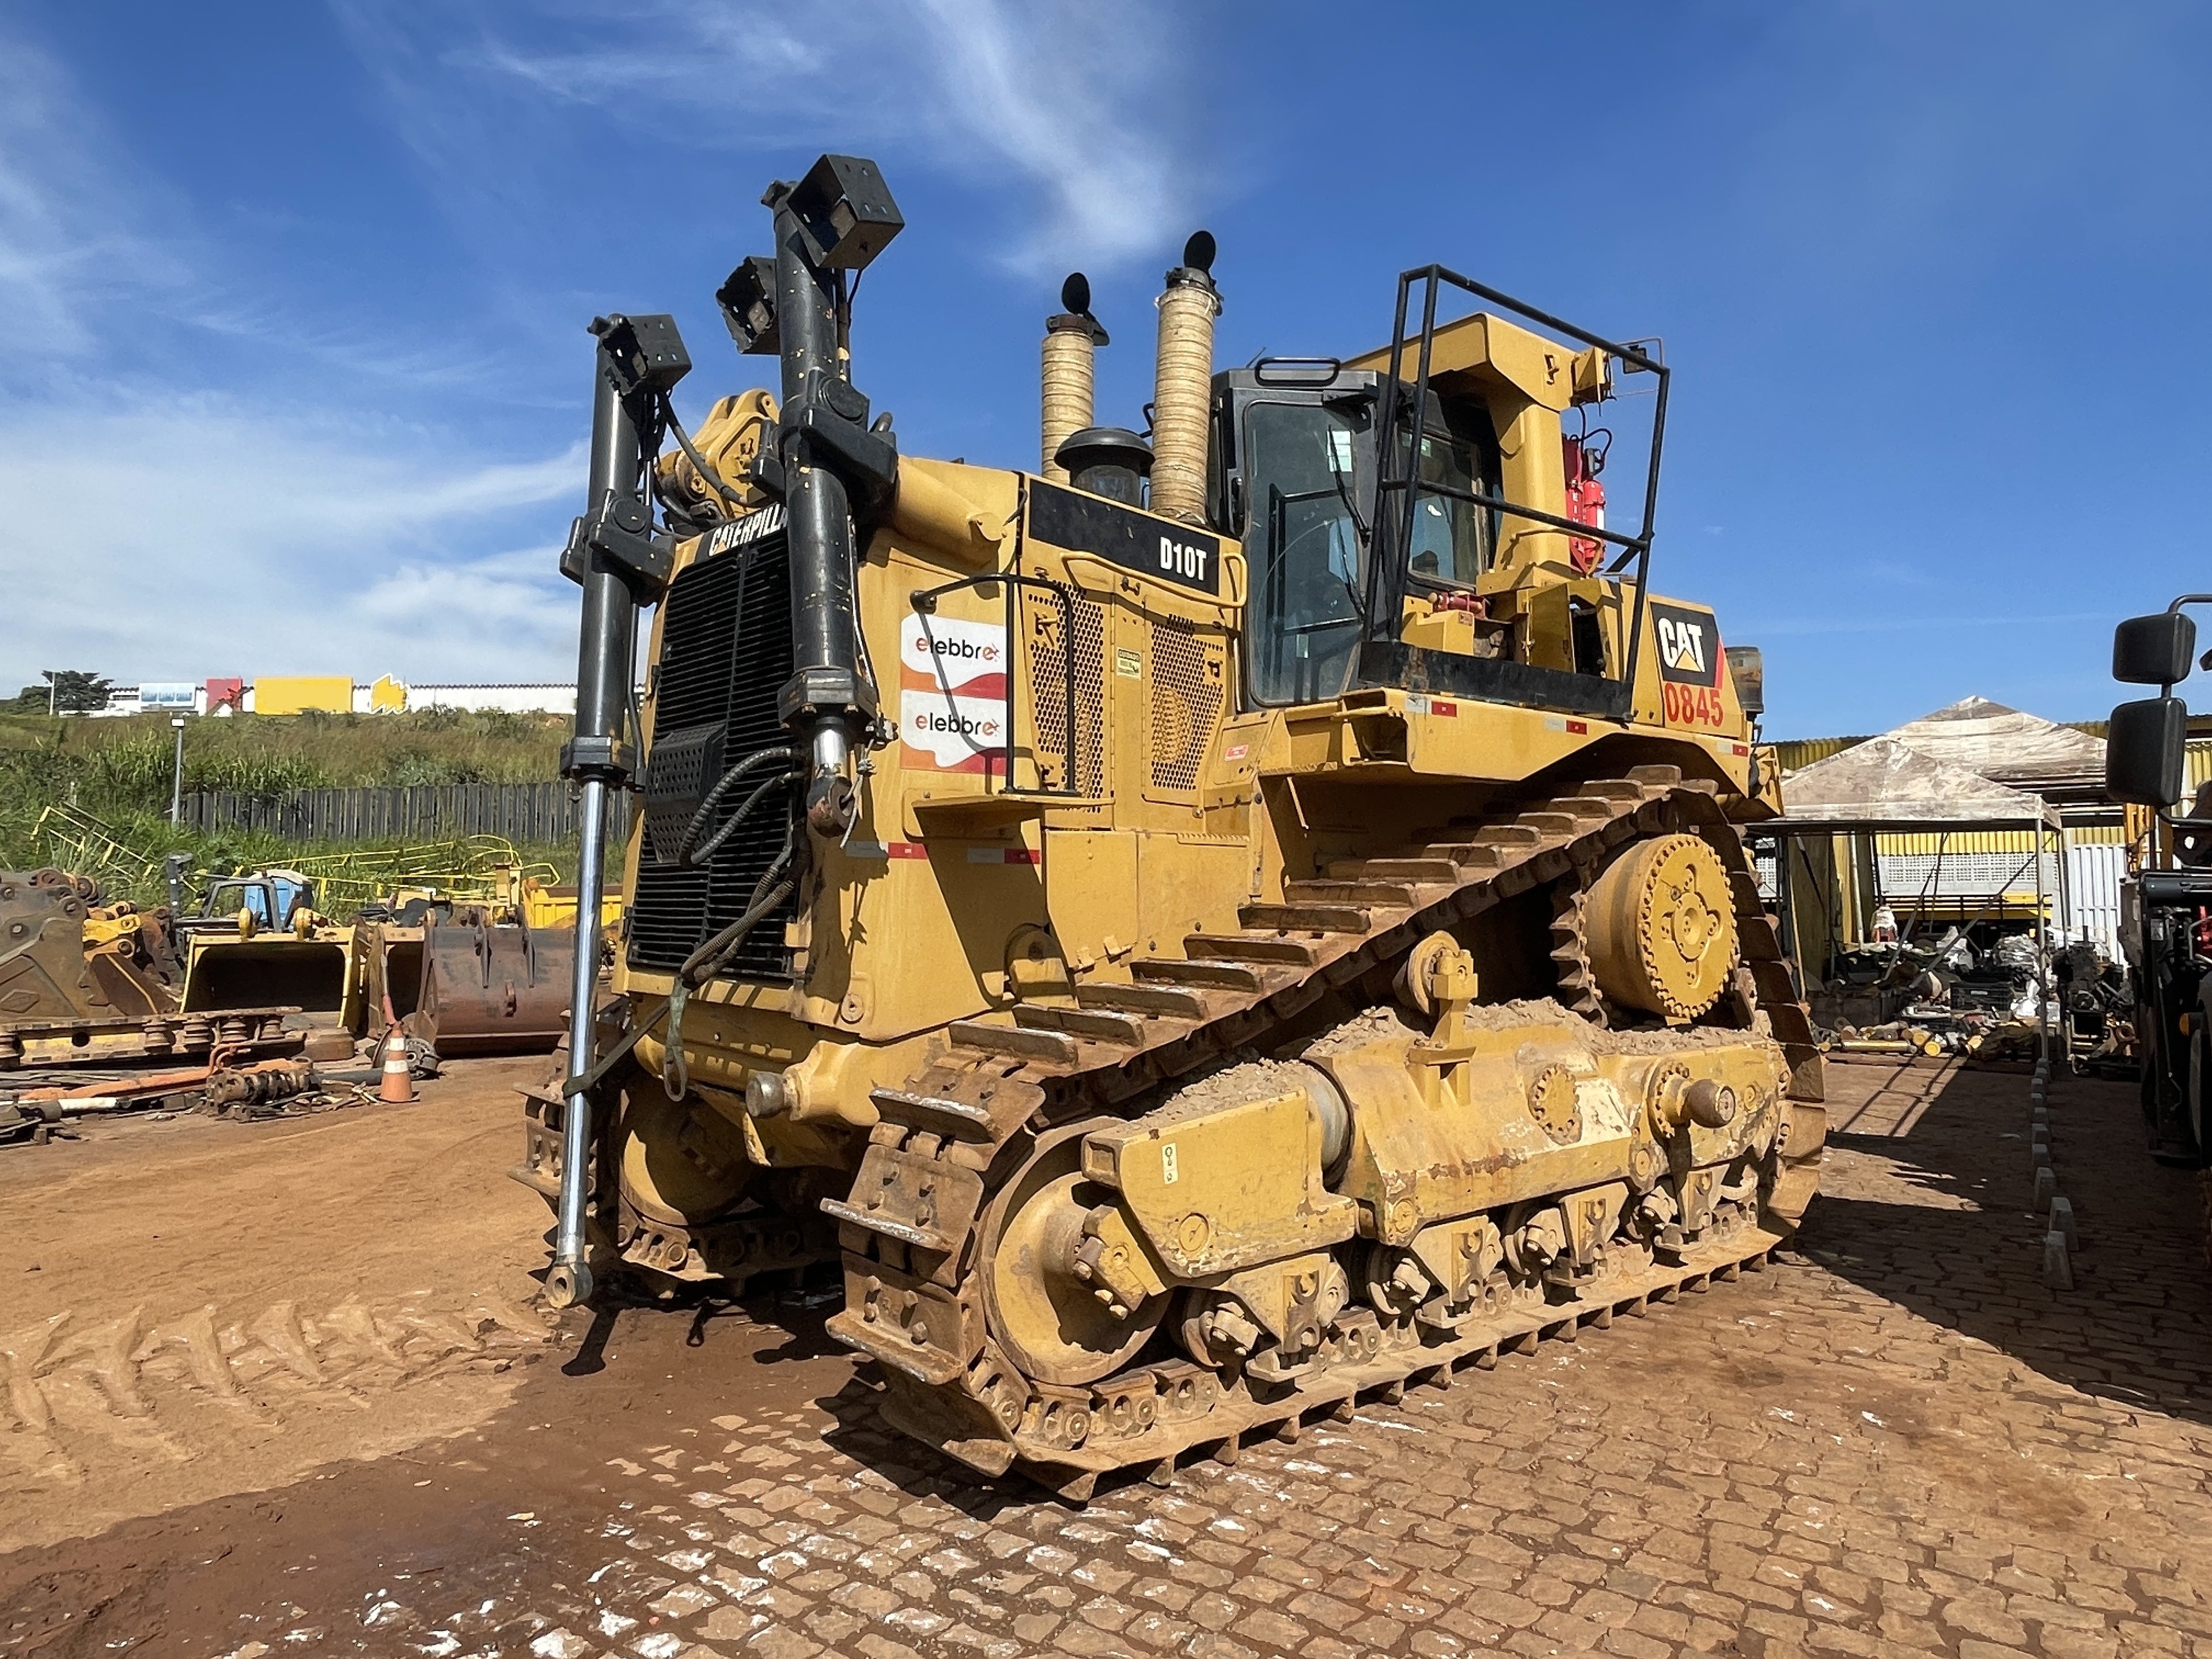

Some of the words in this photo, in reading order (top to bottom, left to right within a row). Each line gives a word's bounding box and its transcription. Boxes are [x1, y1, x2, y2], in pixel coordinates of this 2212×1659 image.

[709, 503, 787, 556] CATERPILLA
[1160, 536, 1207, 581] D10T
[1658, 618, 1706, 673] CAT
[1665, 682, 1724, 727] 0845
